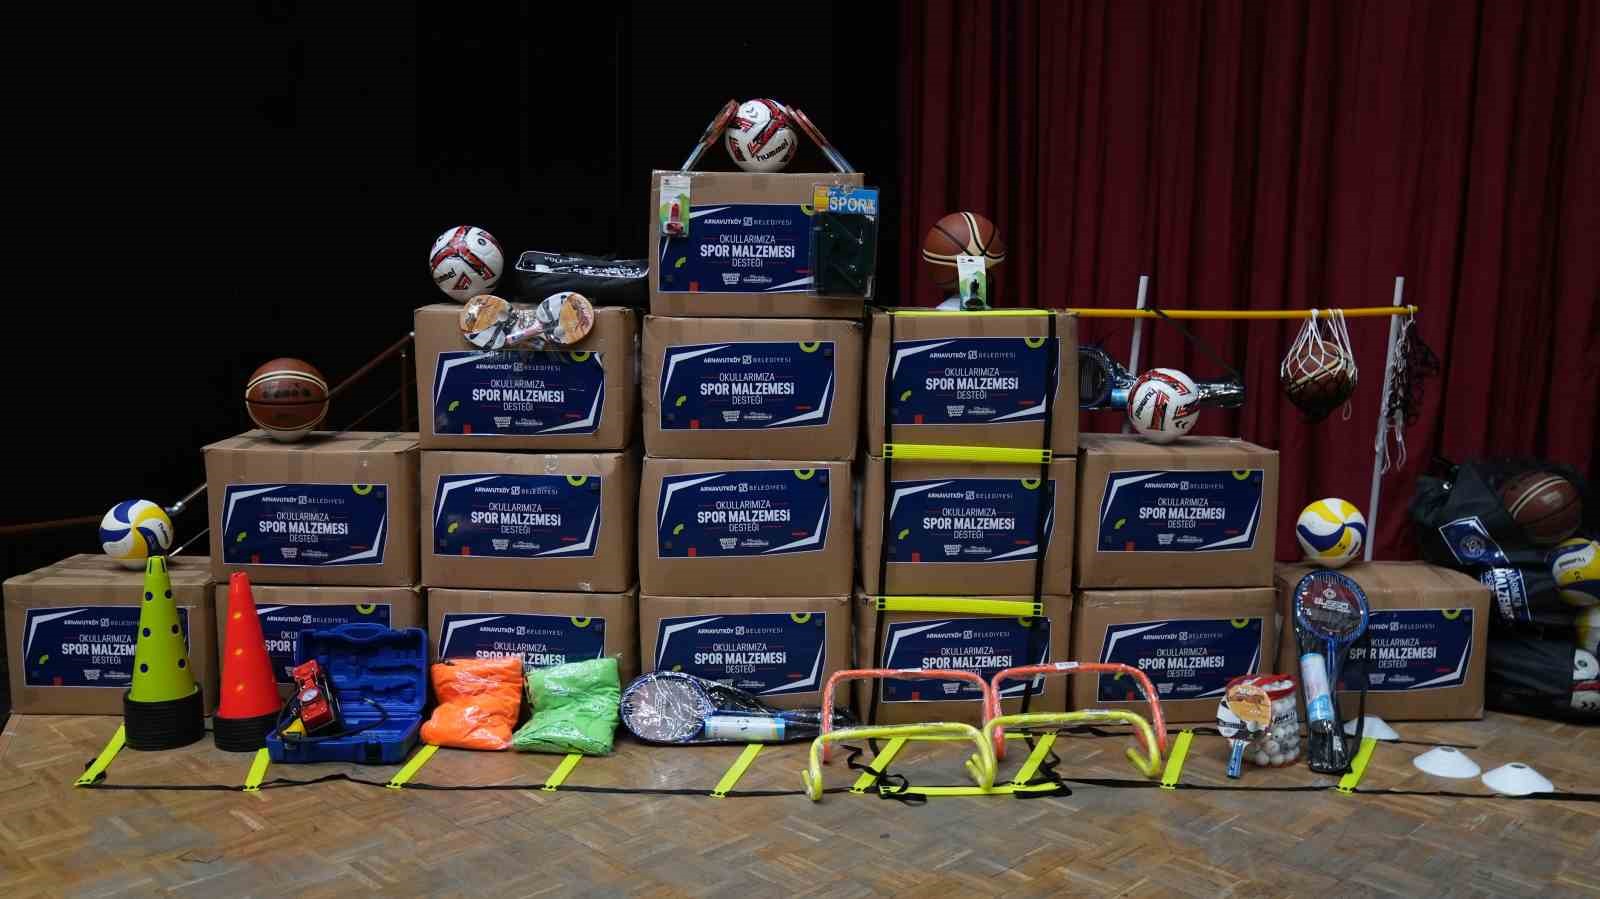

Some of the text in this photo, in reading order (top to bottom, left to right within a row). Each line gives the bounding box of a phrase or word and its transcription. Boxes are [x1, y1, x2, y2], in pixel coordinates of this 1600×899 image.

[756, 138, 789, 161] hummel
[720, 234, 775, 244] OKULLARIMIZA
[700, 244, 729, 257] SPOR
[720, 373, 775, 381] OKULLARIMIZA
[944, 368, 1000, 376] OKULLARIMIZA
[490, 379, 545, 388] OKULLARIMIZA
[925, 378, 954, 390] SPOR
[700, 383, 729, 395] SPOR
[472, 389, 500, 400] SPOR
[716, 500, 771, 509] OKULLARIMIZA
[1158, 498, 1208, 506] OKULLARIMIZA
[489, 503, 542, 512] OKULLARIMIZA
[942, 508, 996, 517] OKULLARIMIZA
[276, 512, 328, 521] OKULLARIMIZA
[471, 512, 498, 524] SPOR
[697, 511, 726, 523] SPOR
[1140, 507, 1166, 519] SPOR
[260, 521, 286, 533] SPOR
[923, 518, 951, 529] SPOR
[80, 634, 131, 643] OKULLARIMIZA
[62, 644, 89, 655] SPOR
[494, 642, 546, 652] OKULLARIMIZA
[713, 642, 767, 651] OKULLARIMIZA
[941, 646, 993, 655] OKULLARIMIZA
[1157, 648, 1208, 656] OKULLARIMIZA
[694, 652, 722, 664] SPOR
[922, 657, 950, 669] SPOR
[1138, 658, 1165, 669] SPOR
